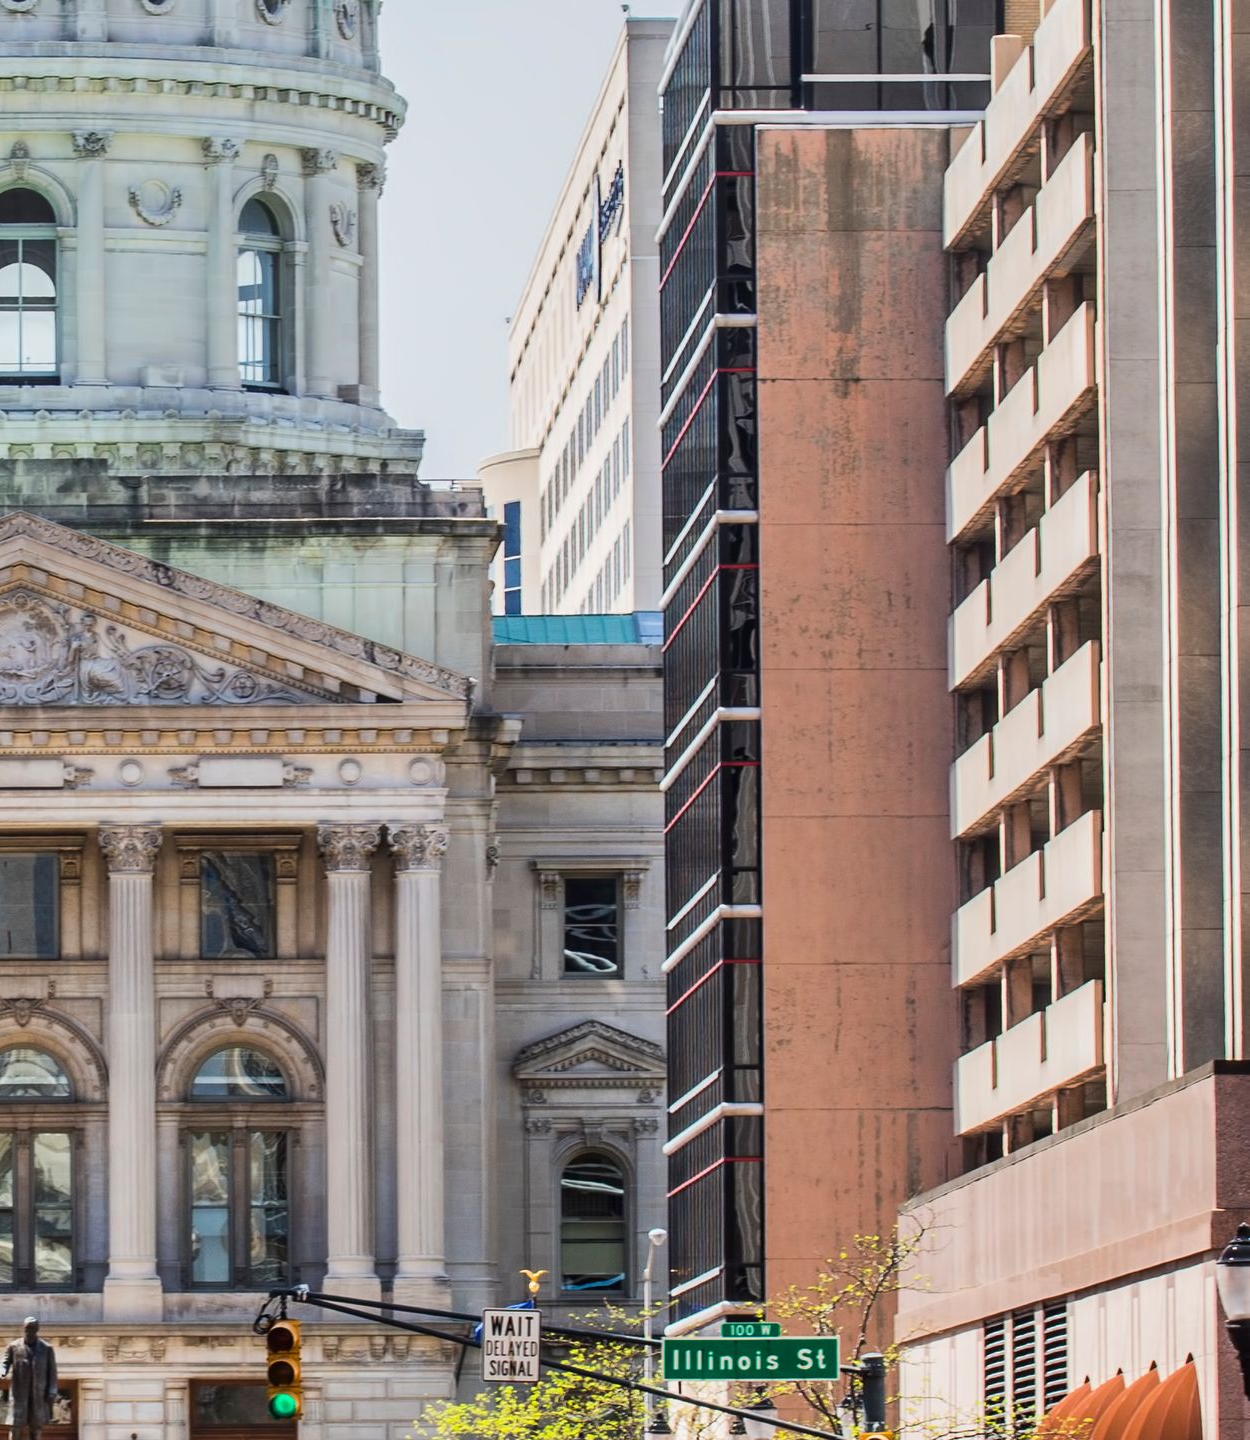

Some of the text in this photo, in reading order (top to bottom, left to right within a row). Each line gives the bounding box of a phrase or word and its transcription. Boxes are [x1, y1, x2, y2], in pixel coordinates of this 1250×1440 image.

[491, 1316, 534, 1337] WAIT
[730, 1324, 771, 1336] 100 W
[485, 1340, 538, 1357] DELAYED
[672, 1348, 827, 1371] Illinois St
[489, 1360, 534, 1377] SIGNAL
